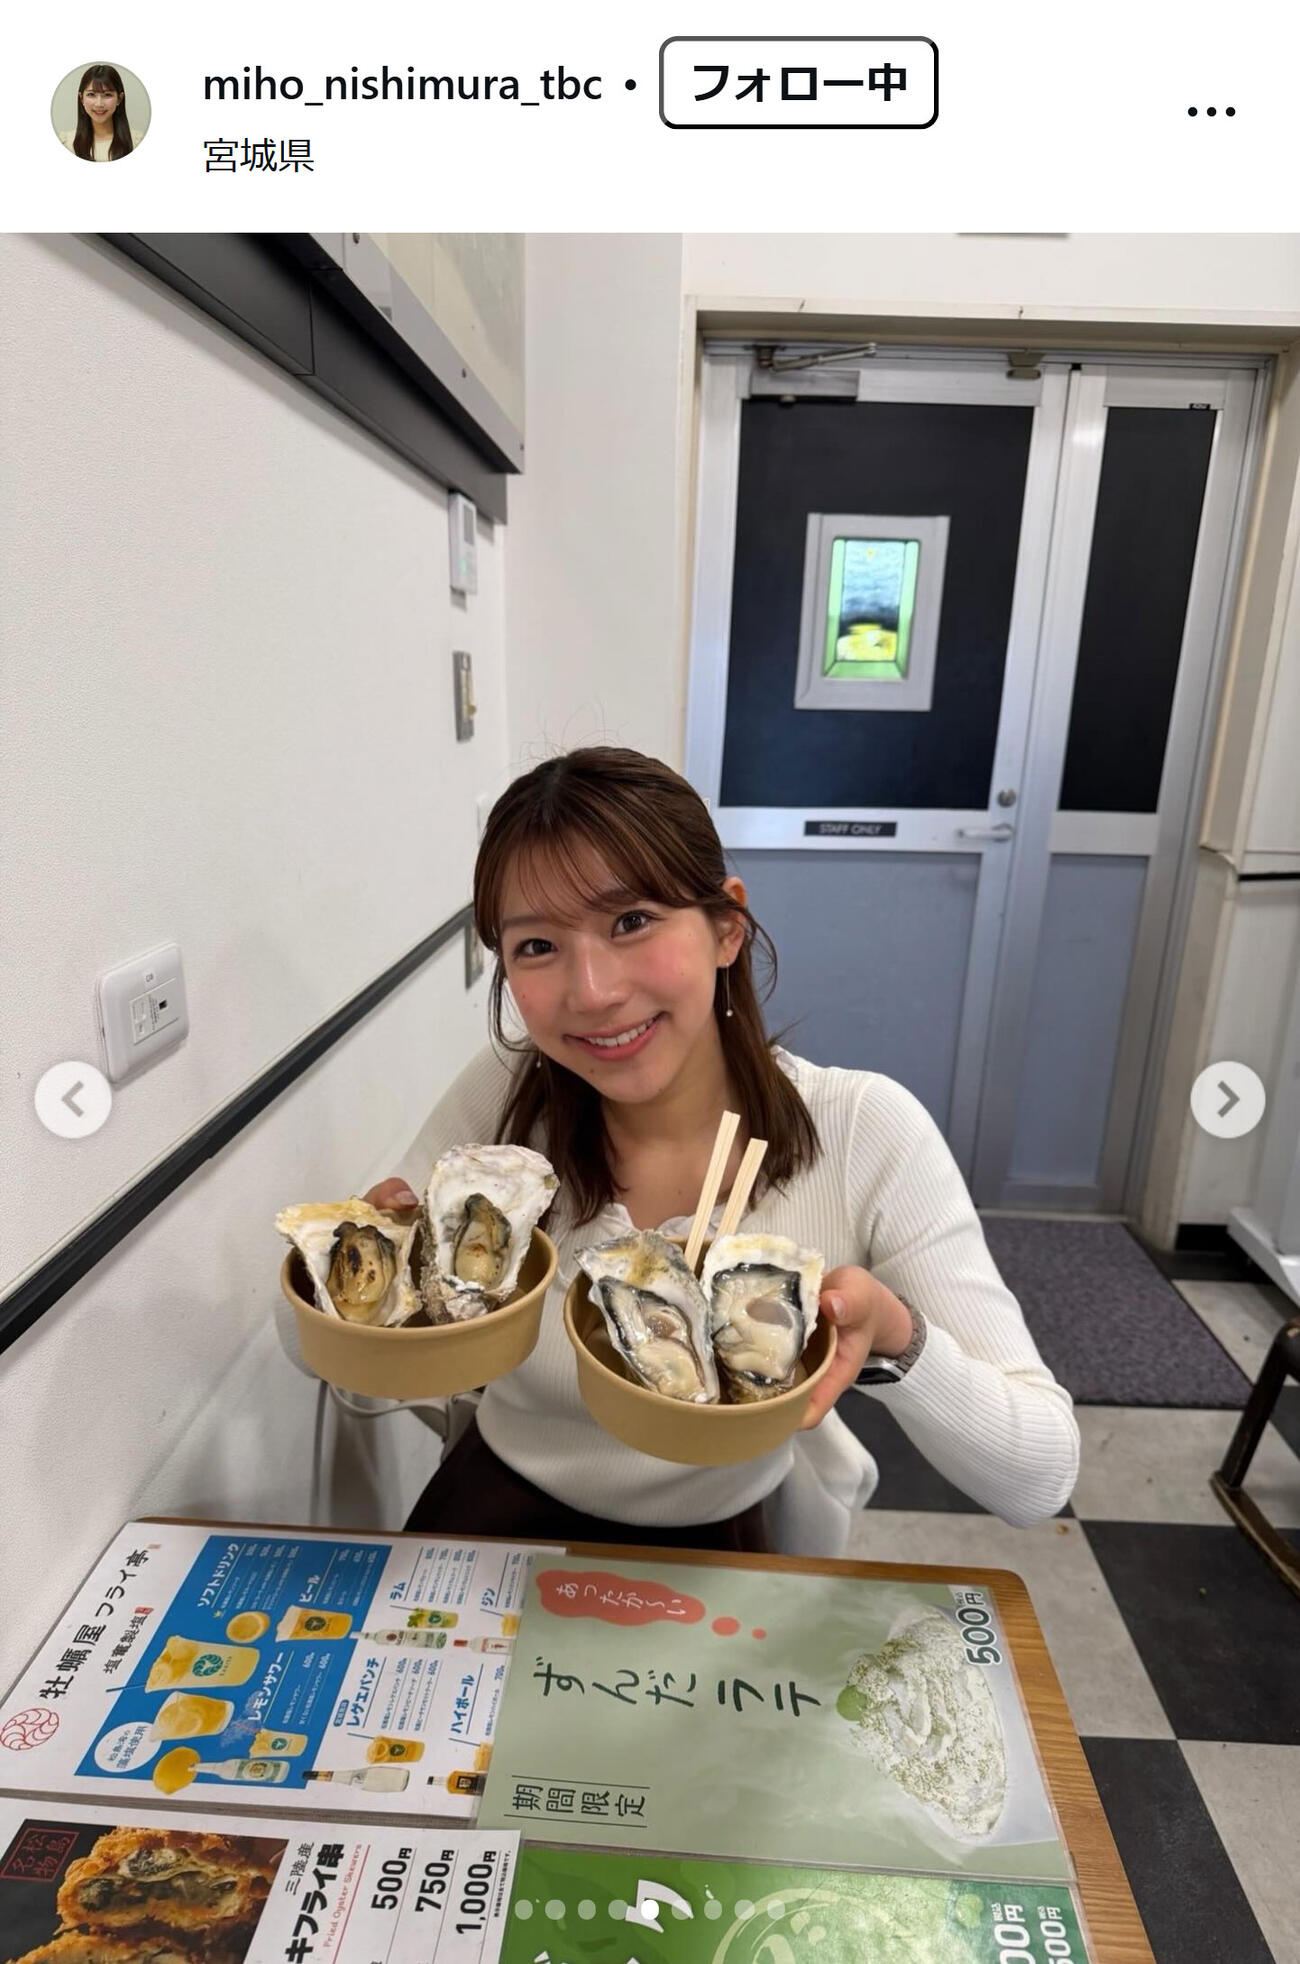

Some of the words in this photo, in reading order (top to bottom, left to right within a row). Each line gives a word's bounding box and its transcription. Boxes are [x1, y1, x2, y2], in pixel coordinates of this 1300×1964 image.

[198, 1543, 239, 1607] ソフトドリンク
[299, 1575, 319, 1604] ビール
[389, 1582, 406, 1602] ラム
[480, 1588, 495, 1608] ジン
[957, 1592, 1002, 1665] 500円
[248, 1651, 284, 1722] レモンサワー
[348, 1657, 380, 1727] レゲエパンチ
[449, 1674, 475, 1734] ハイボール
[533, 1656, 821, 1718] ずんだラテ
[511, 1783, 646, 1818] 期間限定
[285, 1841, 315, 1895] 三陸産
[371, 1847, 412, 1910] 500円
[415, 1849, 454, 1912] 750円
[456, 1850, 496, 1935] 1,000円
